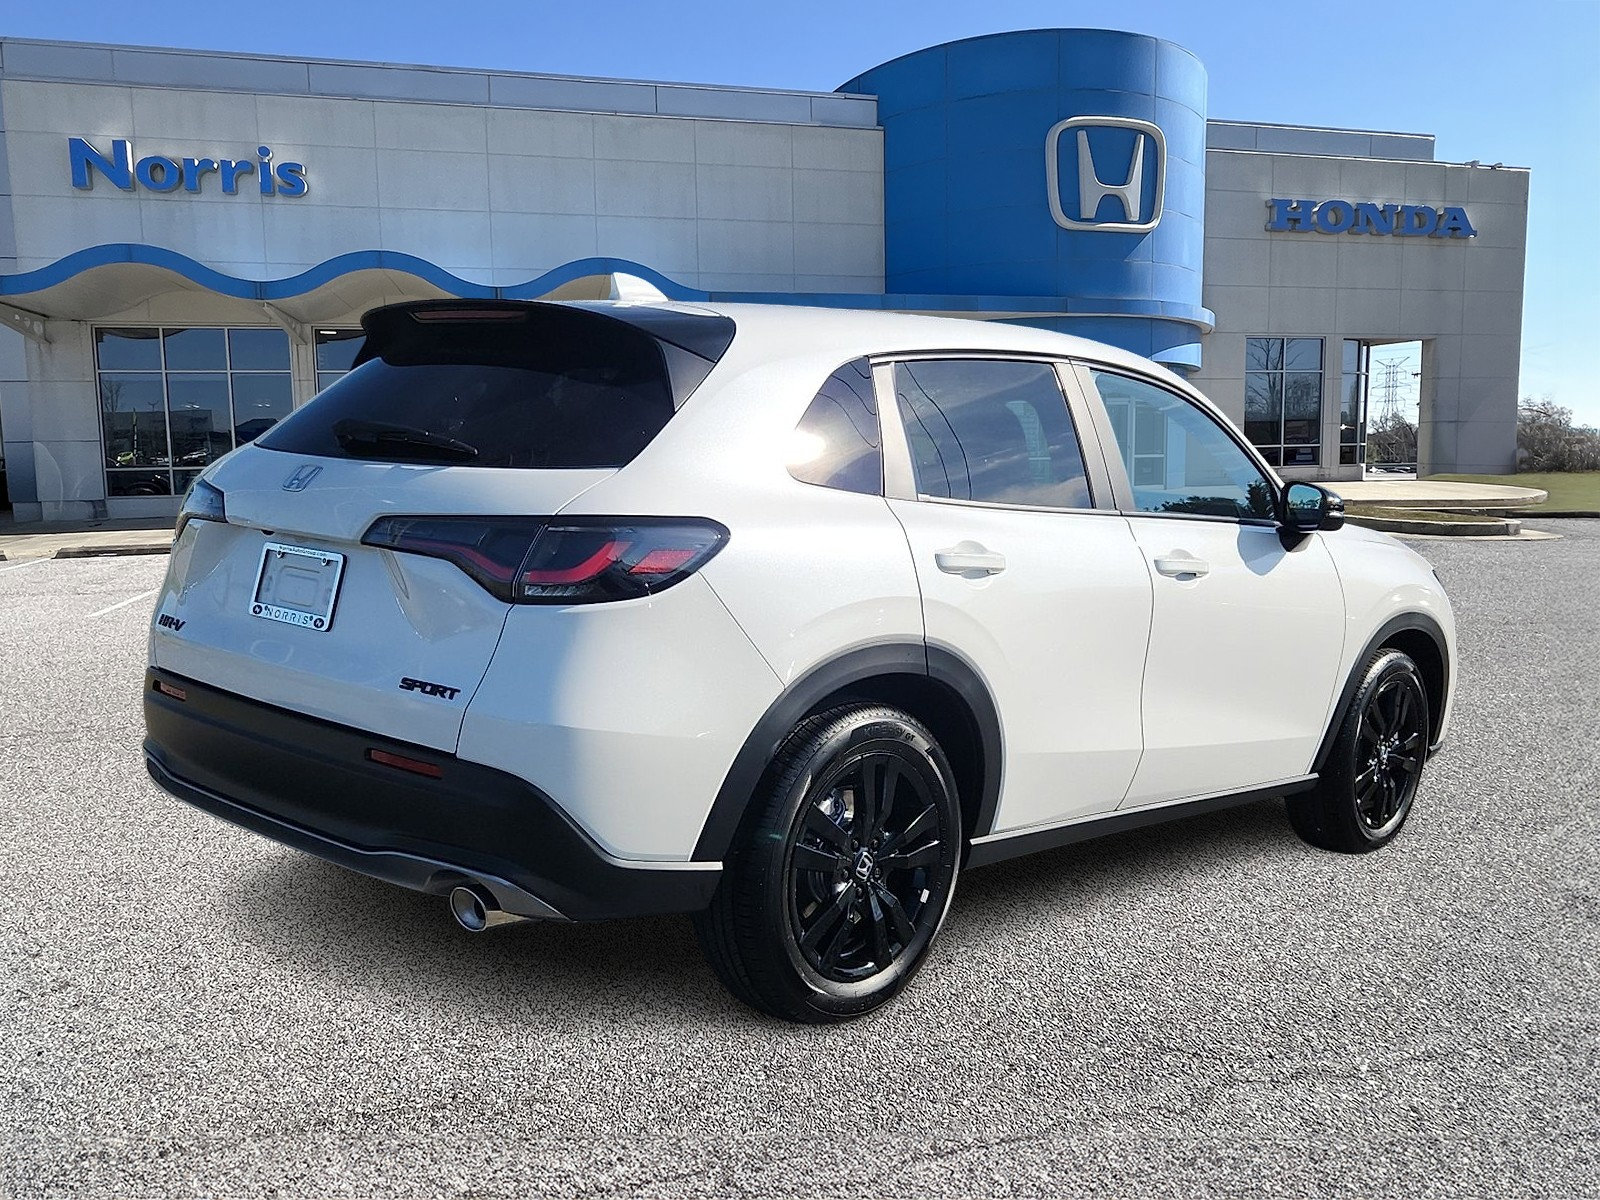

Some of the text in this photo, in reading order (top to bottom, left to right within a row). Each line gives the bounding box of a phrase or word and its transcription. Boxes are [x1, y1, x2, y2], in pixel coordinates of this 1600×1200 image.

[68, 137, 309, 197] Norris
[1265, 198, 1477, 239] HONDA
[158, 613, 187, 631] HR-V
[266, 607, 309, 625] NORRIS
[399, 677, 461, 700] SPORT
